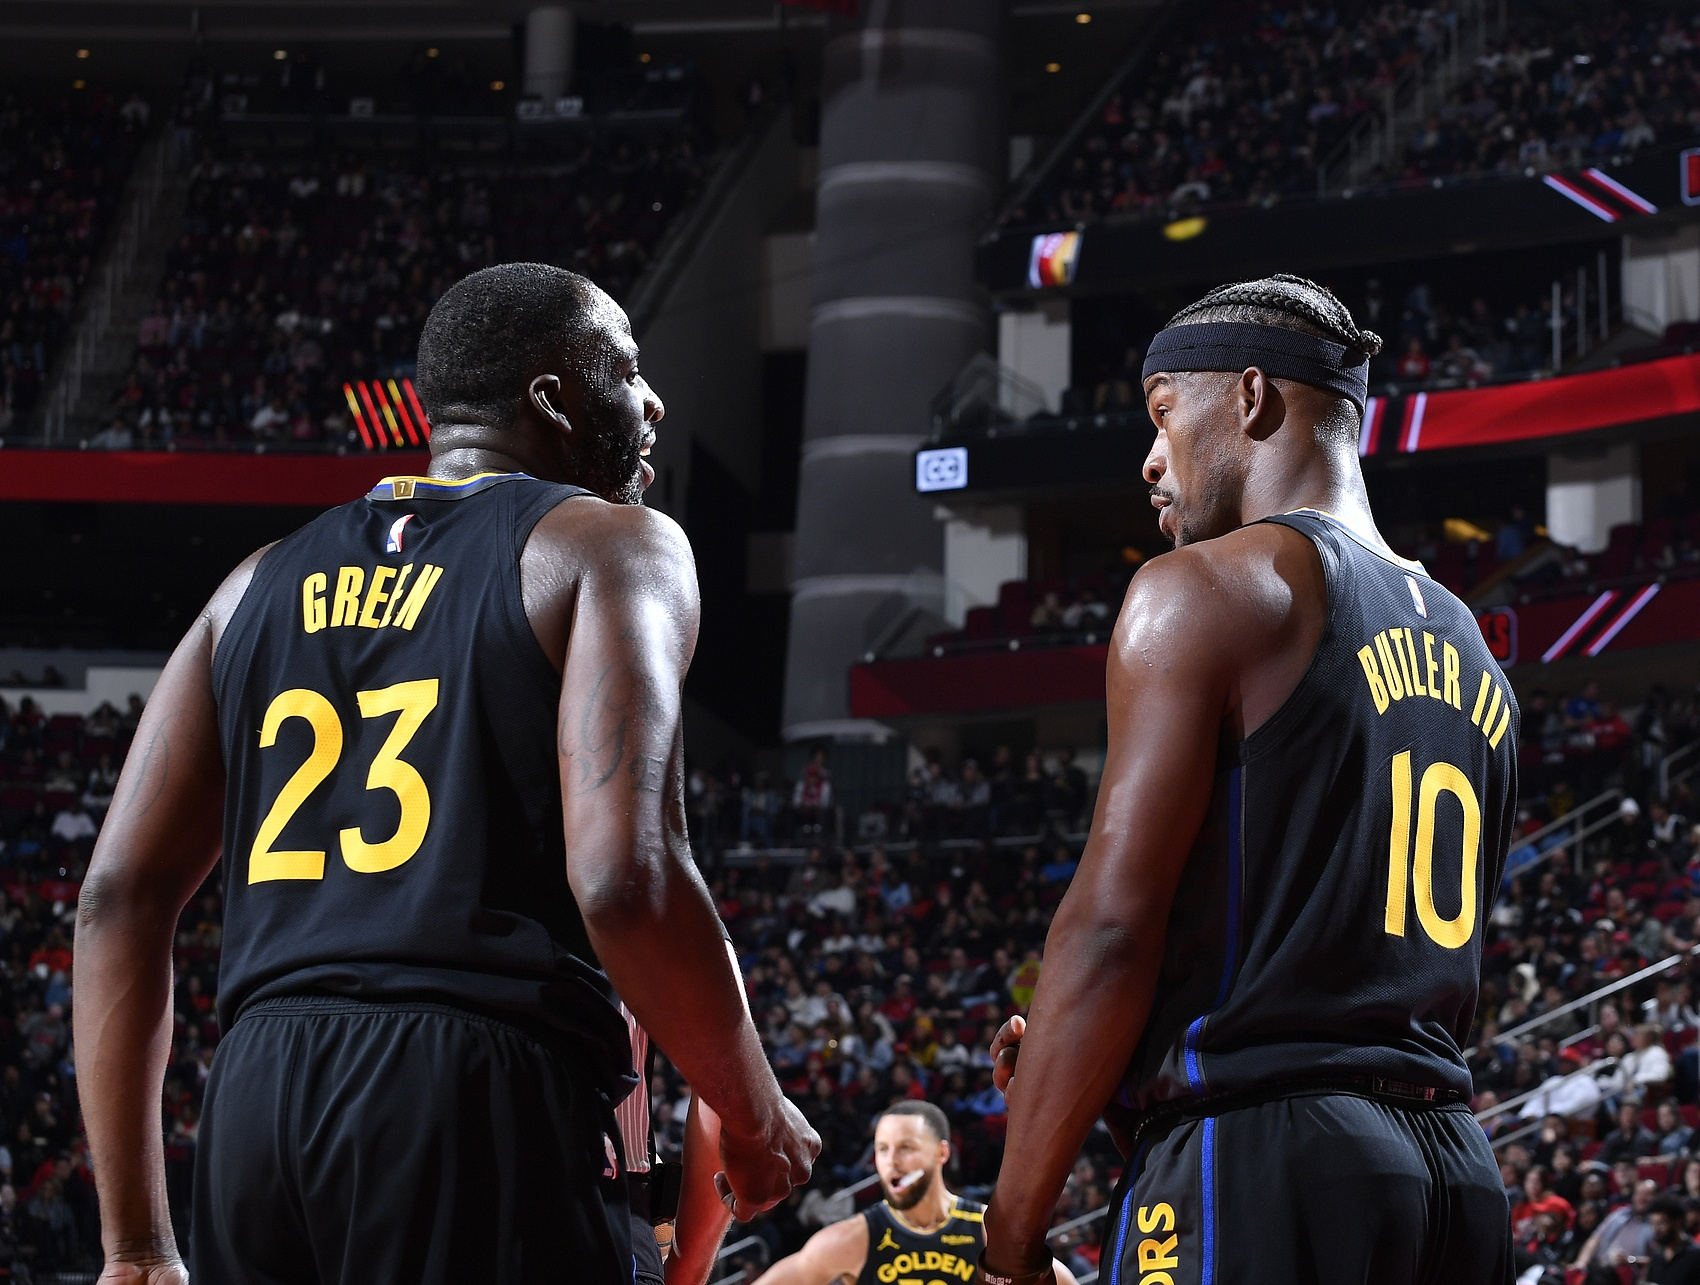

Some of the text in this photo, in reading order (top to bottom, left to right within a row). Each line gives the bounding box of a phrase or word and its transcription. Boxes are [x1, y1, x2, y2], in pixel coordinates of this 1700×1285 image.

[400, 482, 406, 494] 7
[927, 459, 958, 480] CC
[302, 562, 445, 634] GREEN
[1356, 626, 1511, 751] BUTLER III
[247, 677, 440, 886] 23
[1384, 749, 1481, 950] 10
[876, 1250, 975, 1284] GOLDEN
